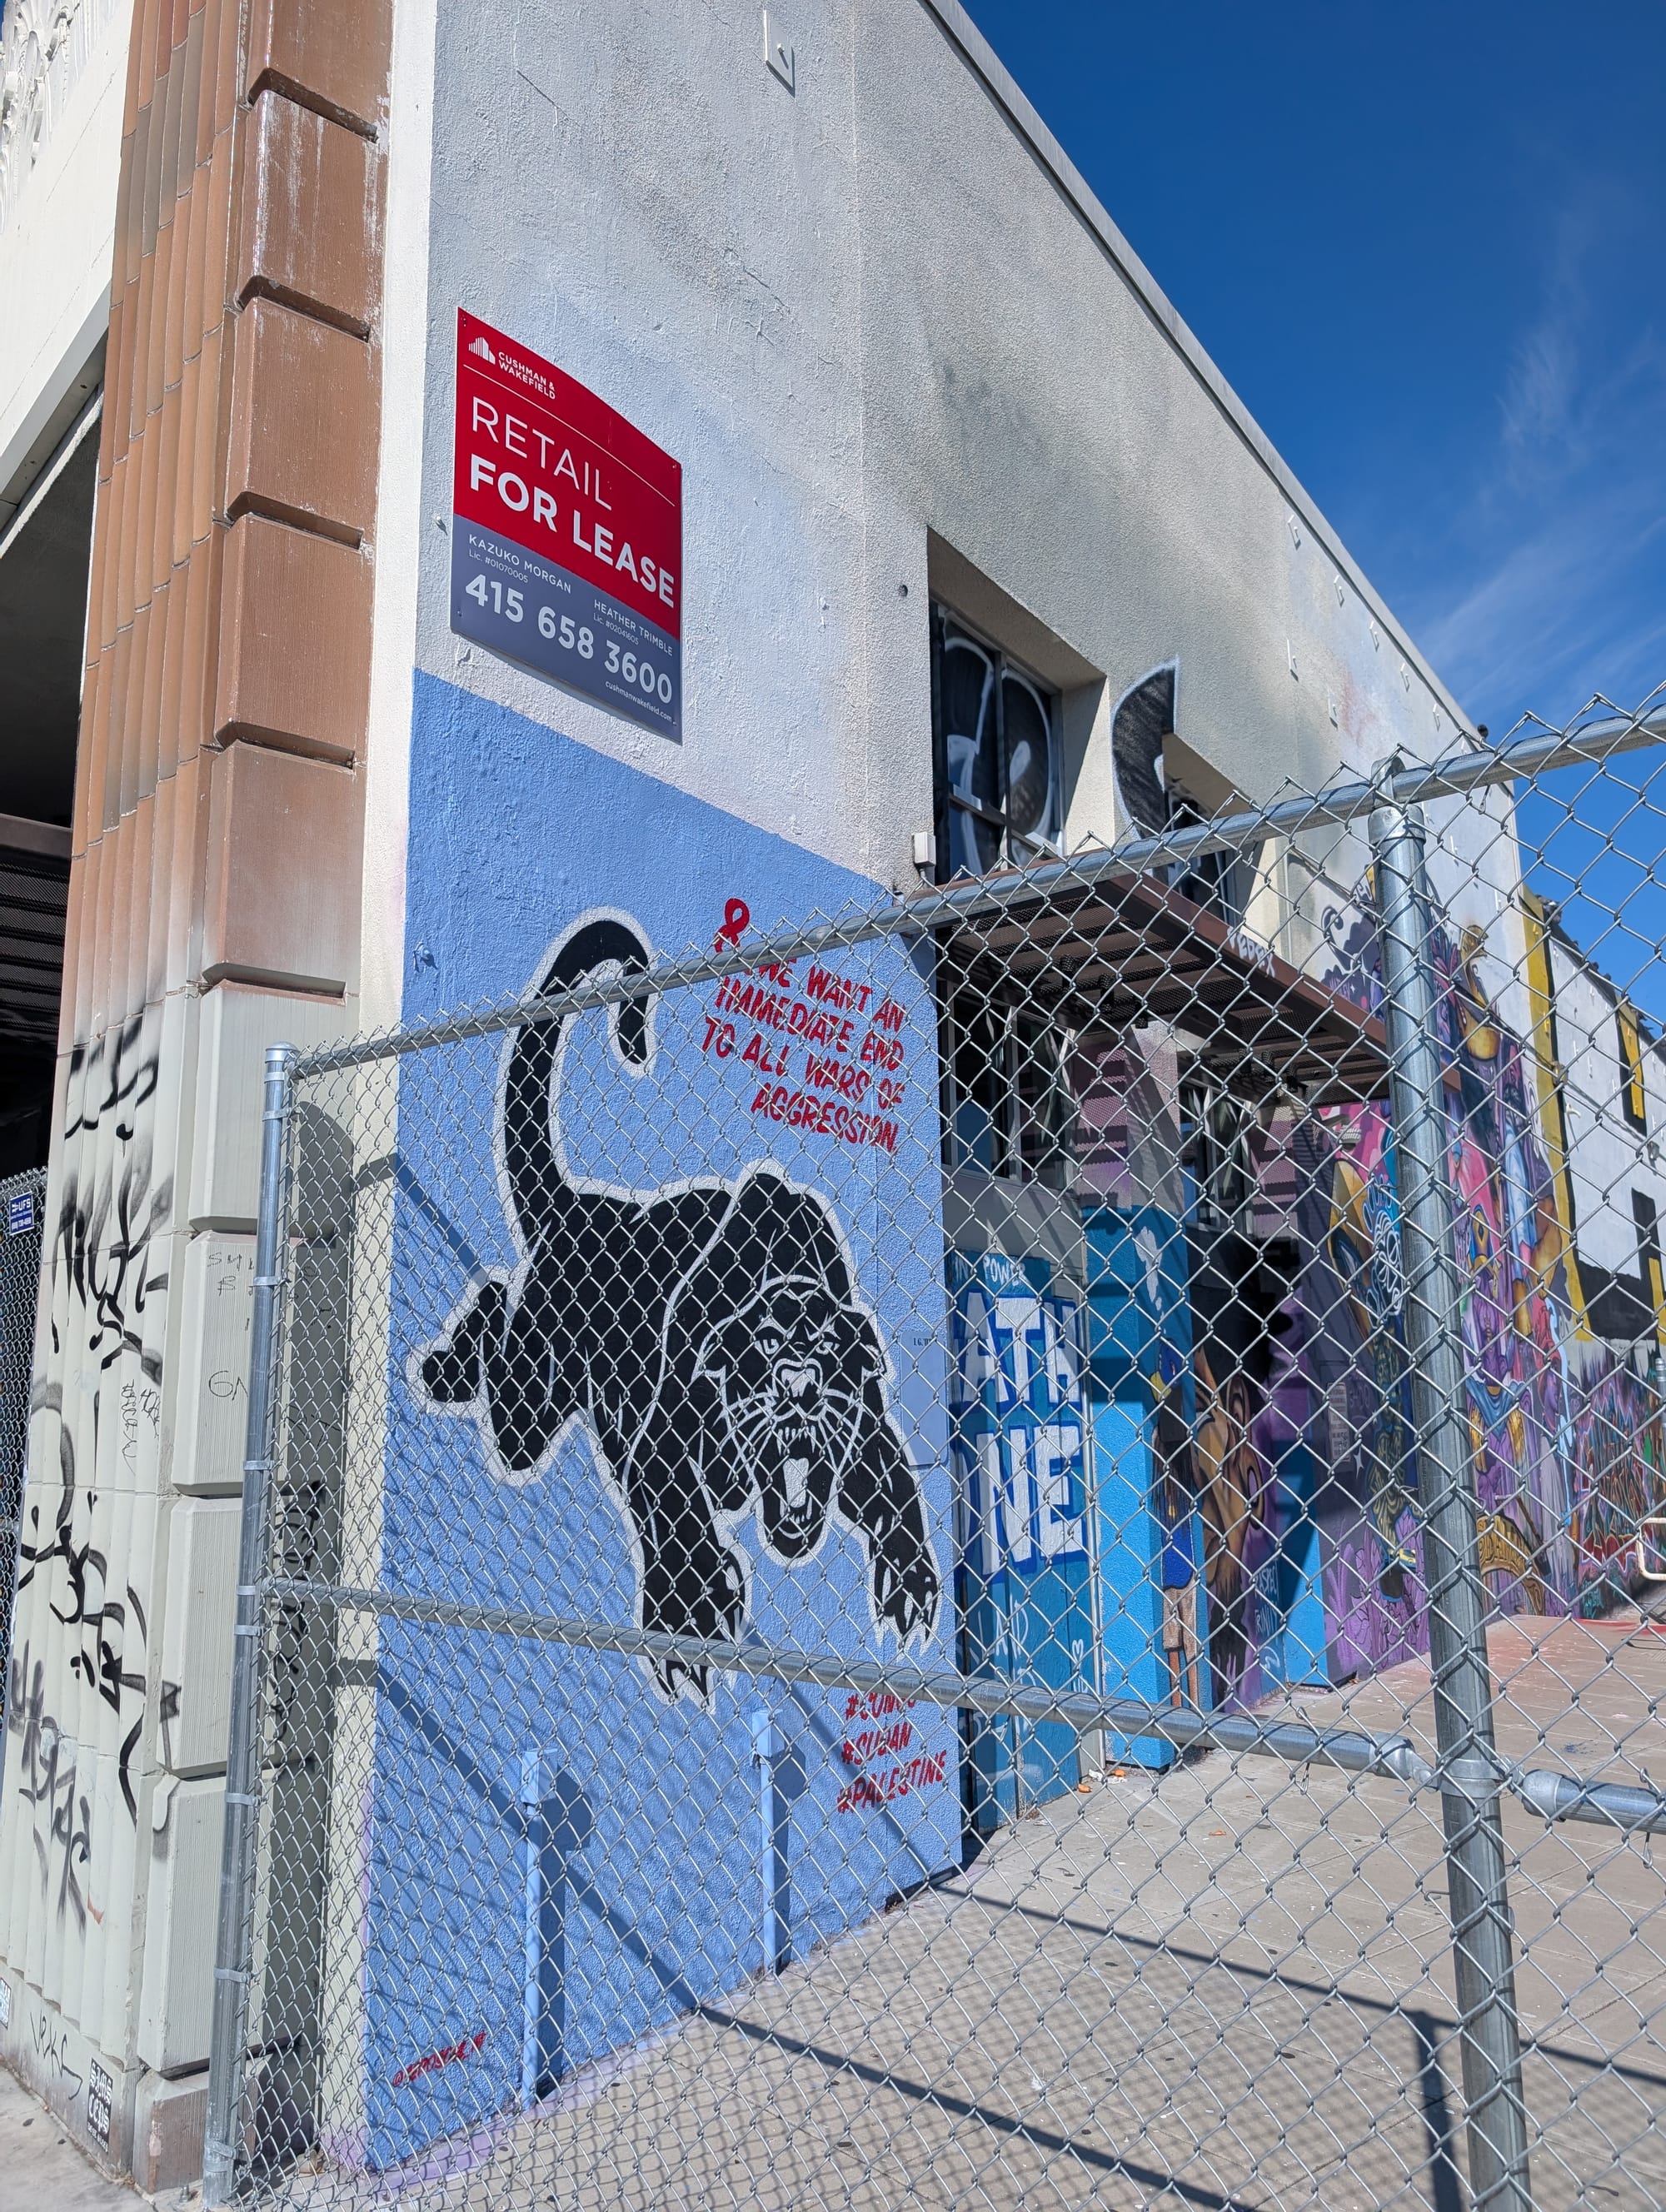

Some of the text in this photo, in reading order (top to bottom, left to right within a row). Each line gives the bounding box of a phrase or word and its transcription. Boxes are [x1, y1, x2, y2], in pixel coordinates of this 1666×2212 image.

[498, 351, 556, 391] CUSHMAN &
[498, 359, 556, 400] WAKEFIELD
[471, 396, 612, 511] RETAIL
[470, 453, 675, 609] FOR LEASE
[469, 534, 571, 594] KAZUKO MORGAN
[485, 556, 529, 583] #01070005
[466, 574, 672, 704] 415 658 3600
[594, 599, 673, 657] HEATHER TRIMBLE
[605, 680, 672, 722] cushmanwakefield.com
[715, 976, 905, 1071] IMMEDIATE END
[806, 966, 873, 1013] WANT
[873, 998, 907, 1033] AN
[701, 1015, 905, 1110] TO ALL WARS OF
